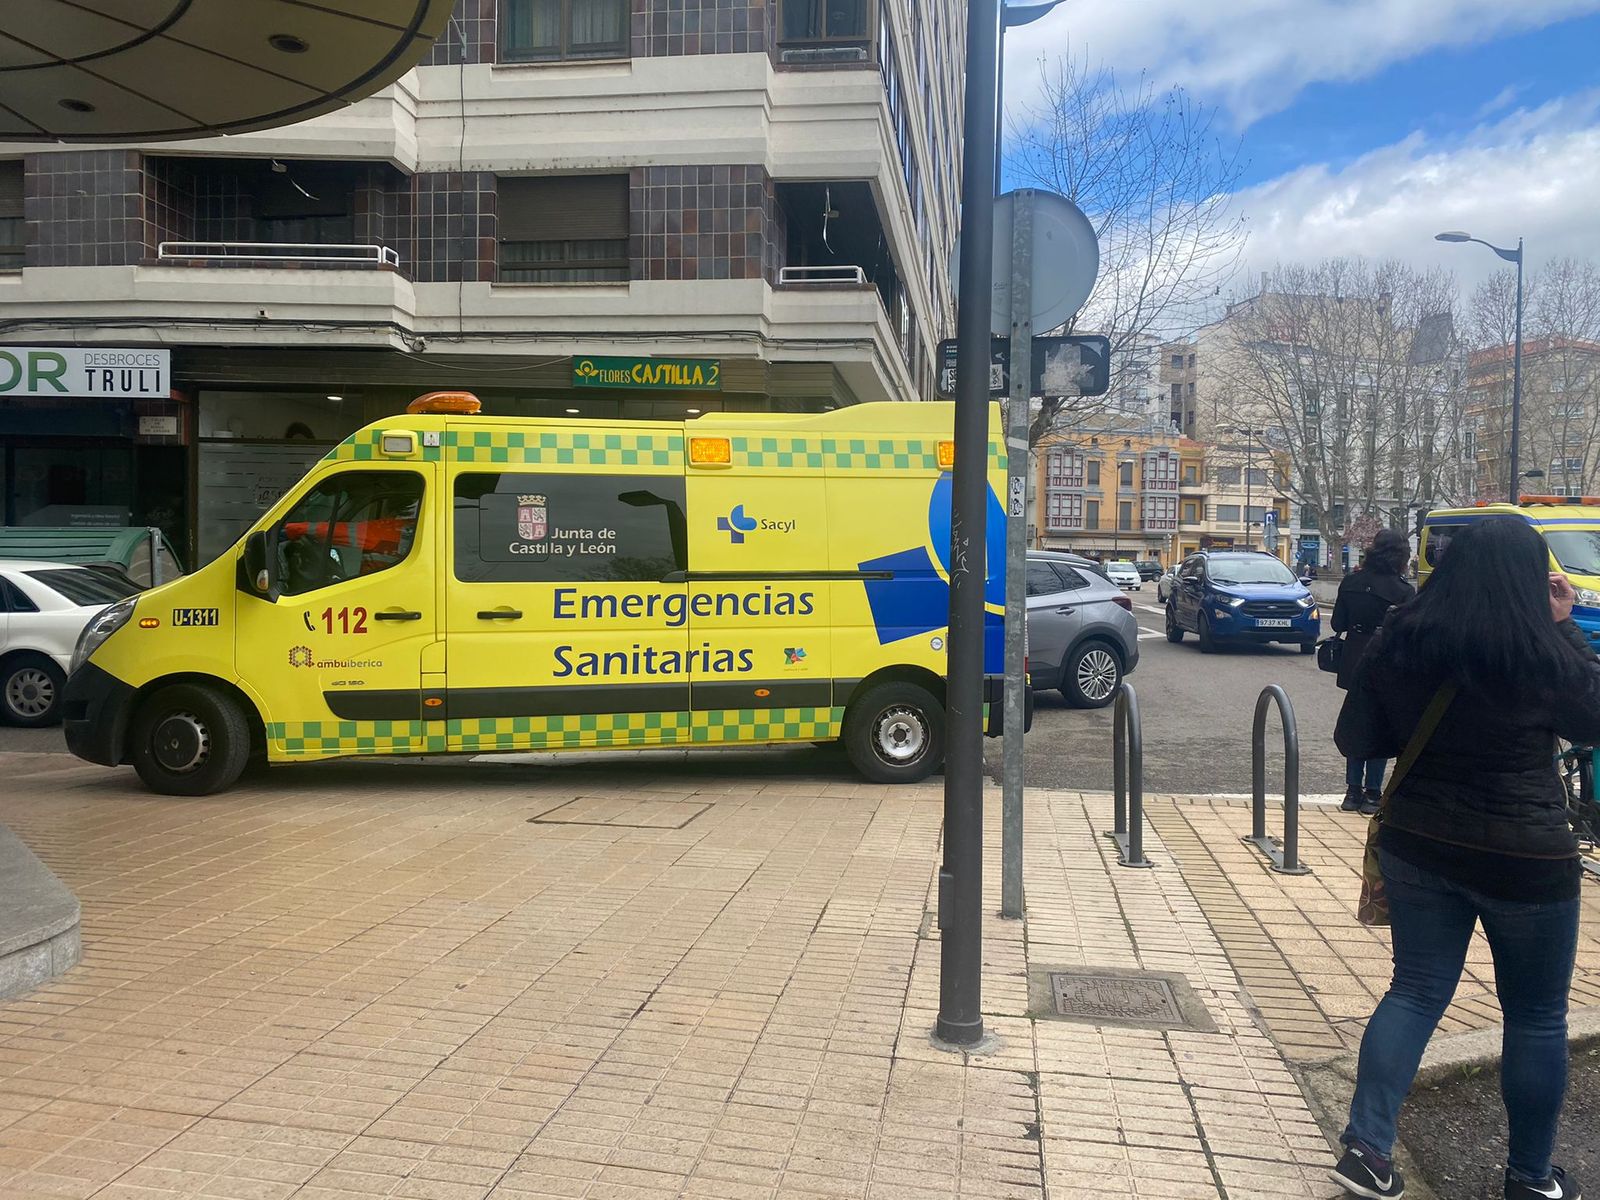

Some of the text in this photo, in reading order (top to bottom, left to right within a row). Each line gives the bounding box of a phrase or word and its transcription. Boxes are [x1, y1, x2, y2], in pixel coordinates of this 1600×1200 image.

[84, 353, 160, 366] DESBROCES
[85, 369, 160, 392] TRULI
[599, 369, 631, 384] FLORES
[631, 364, 704, 385] CASTILLA
[551, 528, 617, 539] Junta de
[761, 518, 796, 534] Sacyl
[509, 542, 617, 557] Castilla y León
[553, 585, 815, 627] Emergencias
[174, 609, 217, 626] U-1311
[321, 607, 368, 634] 112
[317, 659, 383, 669] ambuiberica
[552, 642, 754, 678] Sanitarias
